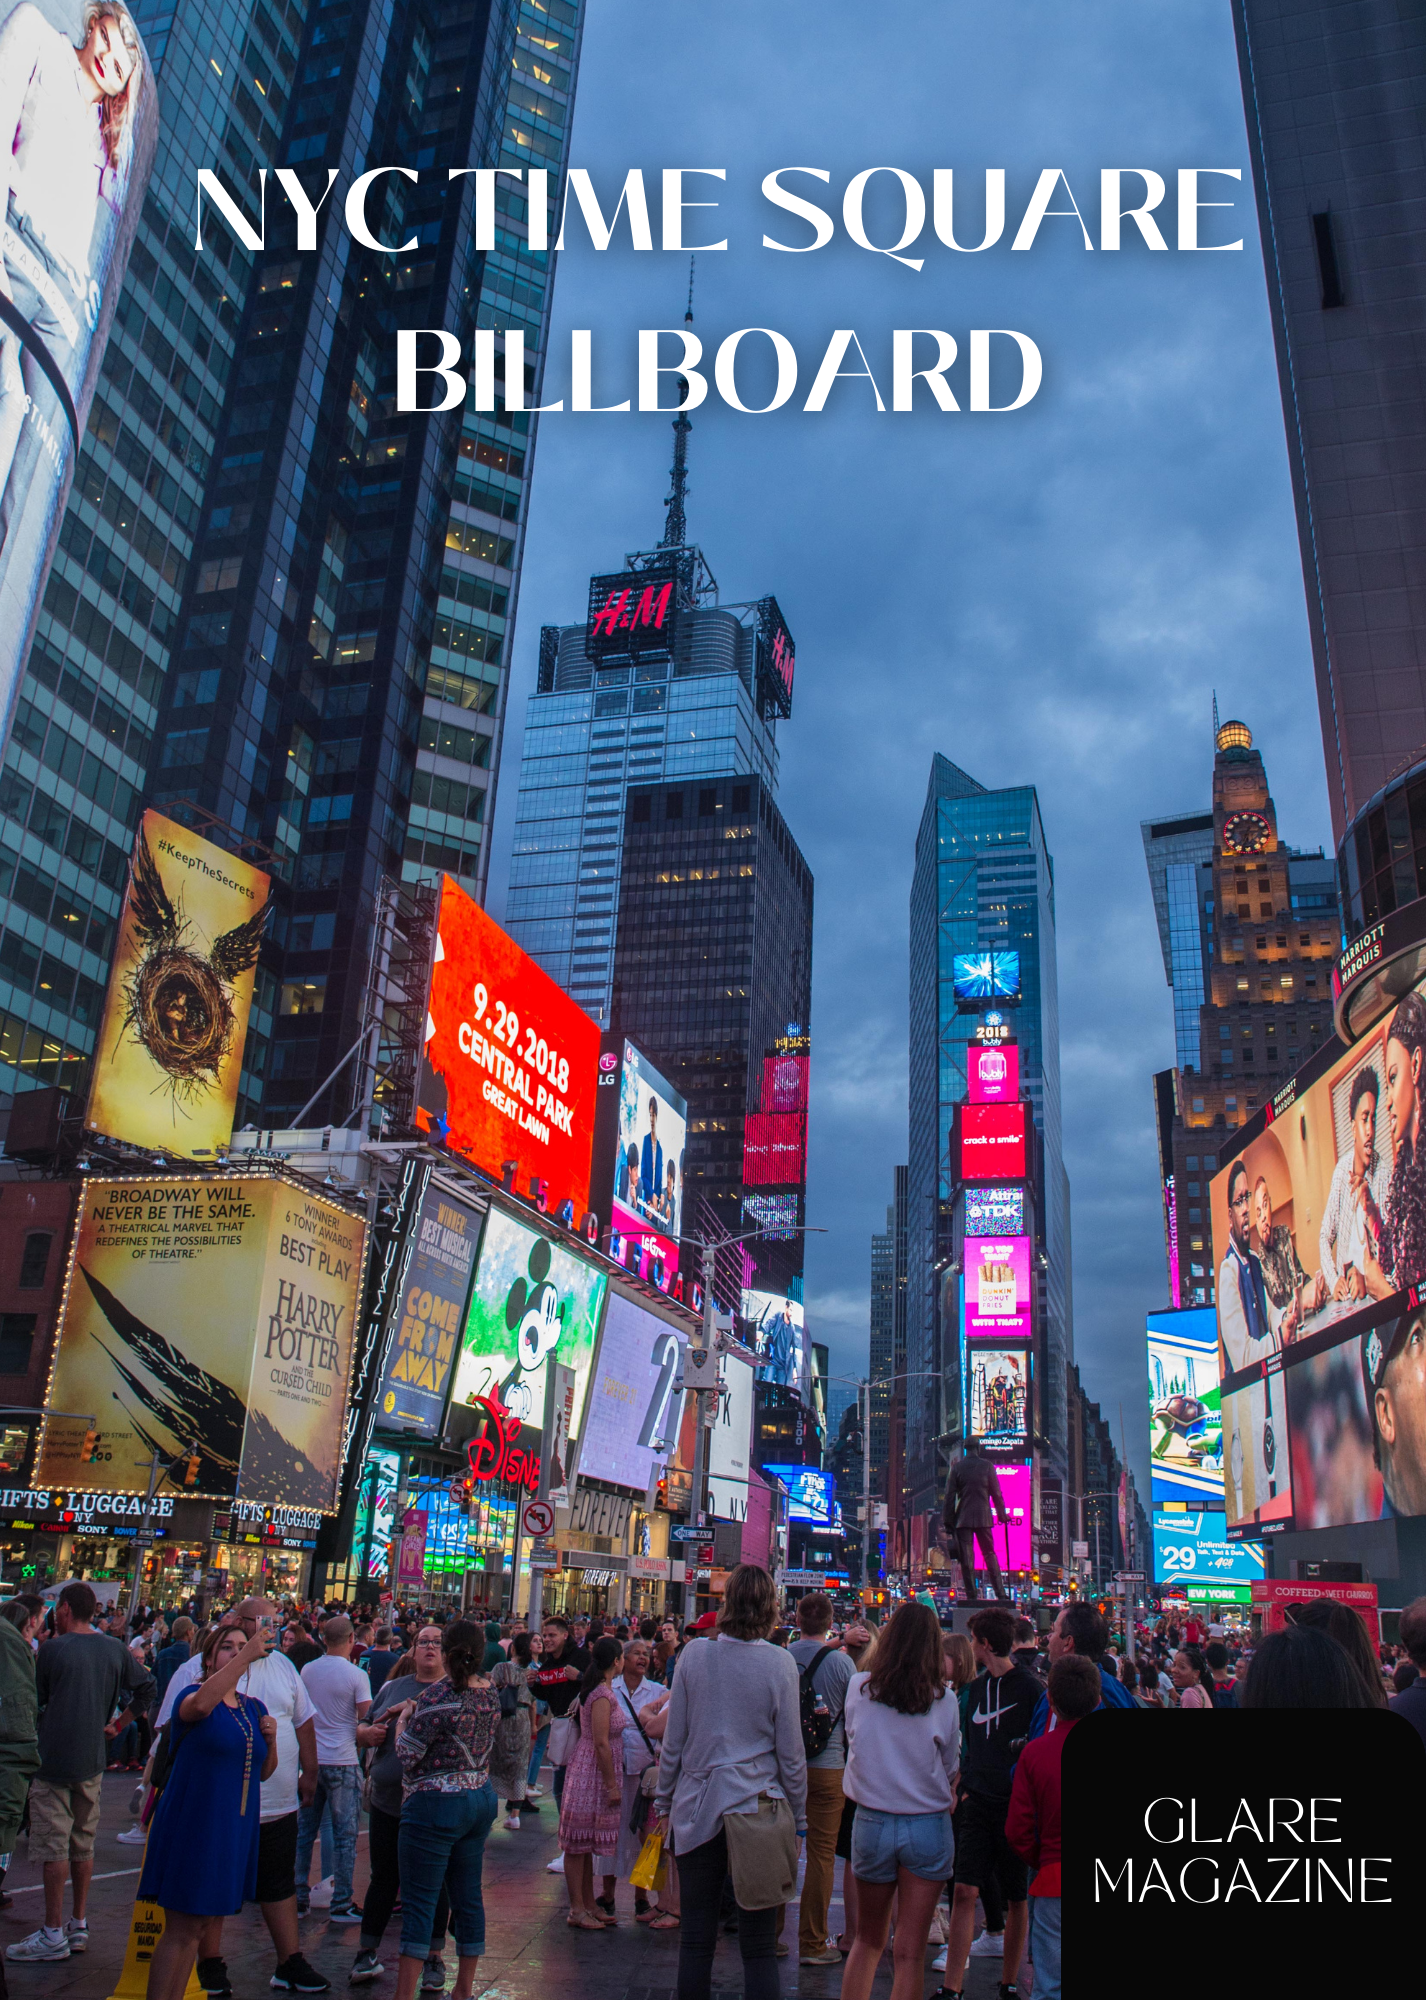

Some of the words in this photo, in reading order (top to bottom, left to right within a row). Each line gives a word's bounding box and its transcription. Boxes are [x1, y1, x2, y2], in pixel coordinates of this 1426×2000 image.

[592, 582, 673, 636] H&M
[157, 838, 255, 900] #KeepTheSecrets
[1340, 924, 1385, 968] MARRIOTT
[1342, 945, 1381, 986] MARQUIS
[474, 983, 569, 1094] 9.29.2018
[976, 1026, 1008, 1038] 2018
[458, 1022, 533, 1112] CENTRAL
[536, 1084, 573, 1136] PARK
[599, 1074, 615, 1085] LG
[1274, 1078, 1296, 1105] MARRIOTT
[482, 1080, 517, 1119] GREAT
[519, 1105, 550, 1145] LAWN
[206, 1187, 245, 1201] WILL
[989, 1191, 1023, 1201] Attra
[92, 1207, 142, 1220] NEVER
[148, 1206, 167, 1219] BE
[173, 1205, 204, 1219] THE
[208, 1204, 255, 1219] SAME.
[304, 1203, 339, 1230] WINNER!
[984, 1205, 1020, 1217] TDK
[98, 1225, 105, 1233] A
[109, 1223, 170, 1233] THEATRICAL
[173, 1223, 213, 1232] MARVEL
[216, 1222, 245, 1231] THAT
[286, 1210, 291, 1223] 6
[293, 1213, 317, 1235] TONY
[319, 1227, 353, 1251] AWARDS
[95, 1237, 148, 1246] REDEFINES
[151, 1236, 171, 1246] THE
[174, 1236, 242, 1245] POSSIBILITIES
[421, 1217, 442, 1246] BEST
[440, 1228, 472, 1263] MUSICAL
[132, 1250, 146, 1259] OF
[280, 1234, 315, 1267] BEST
[318, 1251, 352, 1282] PLAY
[275, 1278, 345, 1339] HARRY
[407, 1286, 461, 1333] COME
[972, 1318, 995, 1327] WITH
[264, 1315, 342, 1376] POTTER
[291, 1365, 303, 1376] AND
[303, 1367, 314, 1378] THE
[390, 1349, 449, 1392] AWAY
[271, 1368, 305, 1391] CURSED
[305, 1379, 332, 1397] CHILD
[979, 1437, 1002, 1446] omingo
[1002, 1437, 1024, 1446] Zapata
[0, 1488, 50, 1510] IFTS
[66, 1493, 174, 1517] LUGGAGE
[73, 1512, 94, 1524] NY
[271, 1507, 322, 1530] LUGGAGE
[569, 1486, 633, 1538] FOREVER
[12, 1520, 35, 1530] Nikon
[40, 1523, 70, 1533] Canon
[77, 1525, 109, 1535] SONY
[113, 1527, 137, 1536] BOWER
[274, 1525, 287, 1536] NY
[283, 1538, 302, 1547] SONY
[643, 1558, 657, 1570] POLO
[582, 1568, 608, 1586] FOREVER
[1209, 1589, 1236, 1599] YORK
[1275, 1586, 1321, 1598] COFFEED
[1325, 1589, 1345, 1599] SWEET
[1346, 1589, 1374, 1600] CHURROS
[538, 1673, 554, 1682] New
[145, 1910, 154, 1921] LA
[133, 1922, 163, 1935] SEGURIDAD
[137, 1935, 155, 1947] MANDA
